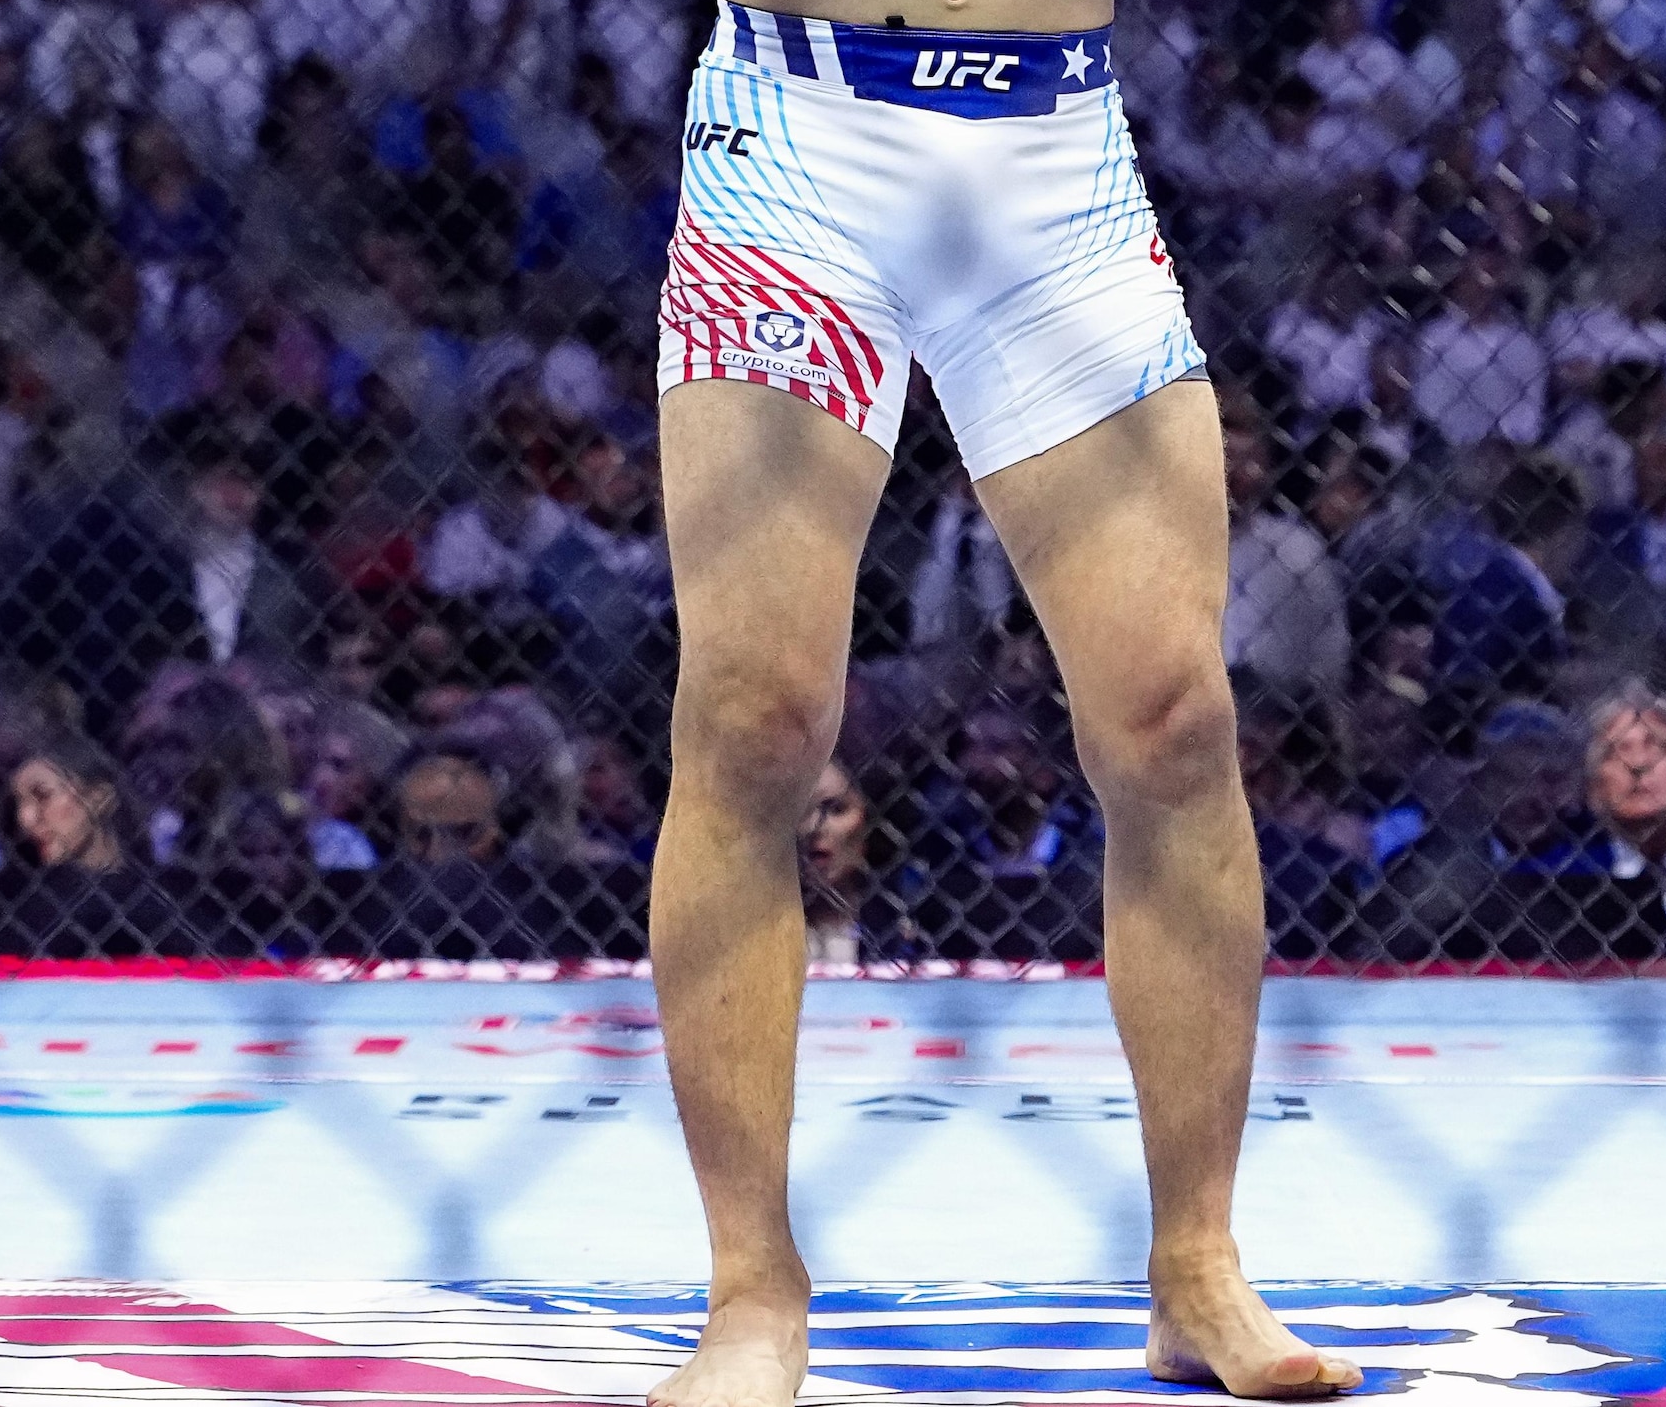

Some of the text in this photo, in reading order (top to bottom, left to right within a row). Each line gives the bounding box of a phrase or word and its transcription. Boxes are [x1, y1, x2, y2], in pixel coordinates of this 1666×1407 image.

[912, 50, 1020, 92] UFC
[686, 121, 759, 157] UFC
[721, 350, 827, 382] crypto.com
